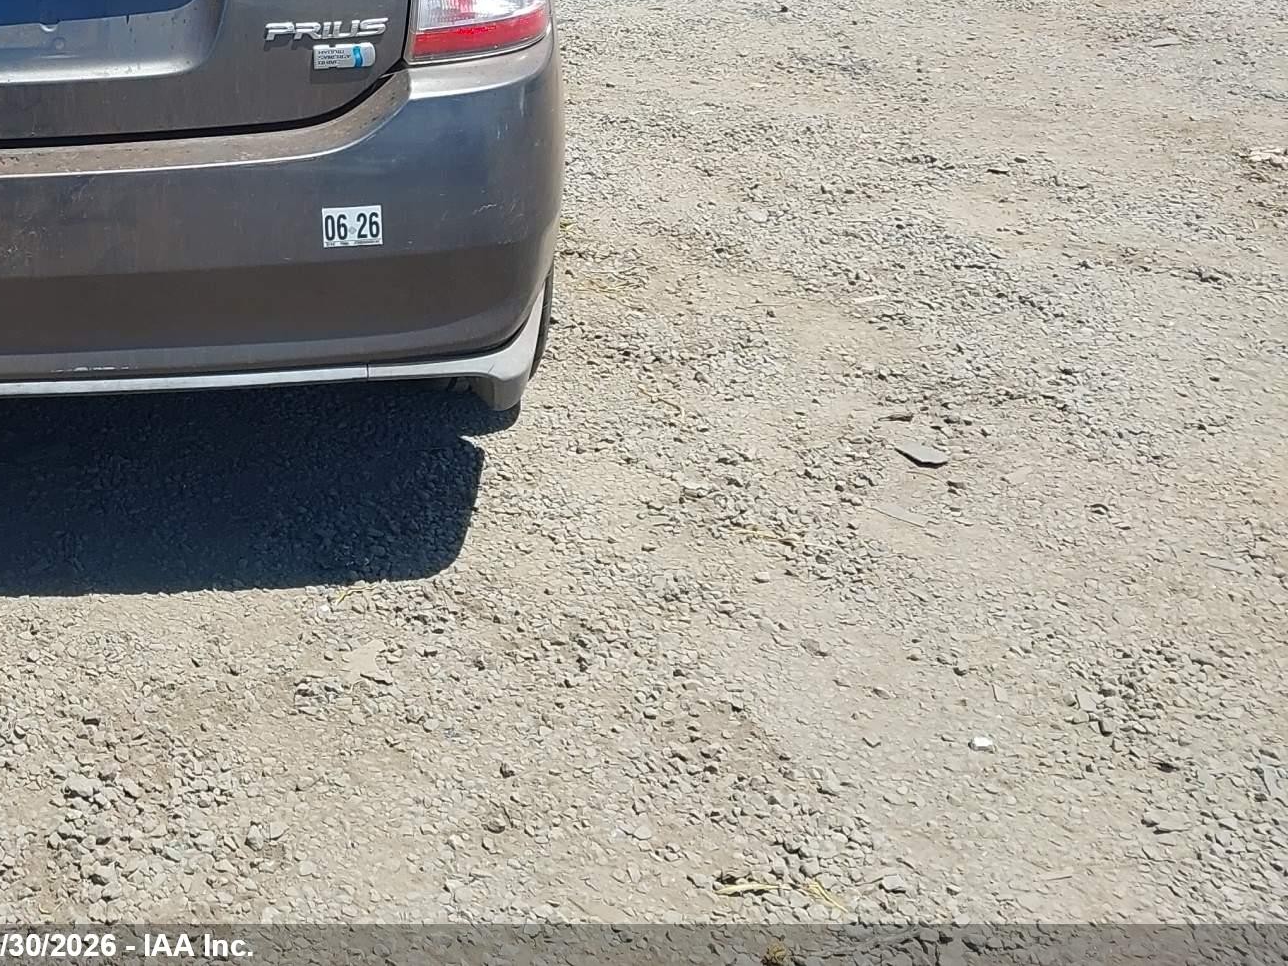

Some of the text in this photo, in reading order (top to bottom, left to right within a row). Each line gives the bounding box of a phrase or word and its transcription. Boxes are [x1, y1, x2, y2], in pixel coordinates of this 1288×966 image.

[264, 17, 389, 41] PRIUS
[324, 211, 380, 241] 06 26
